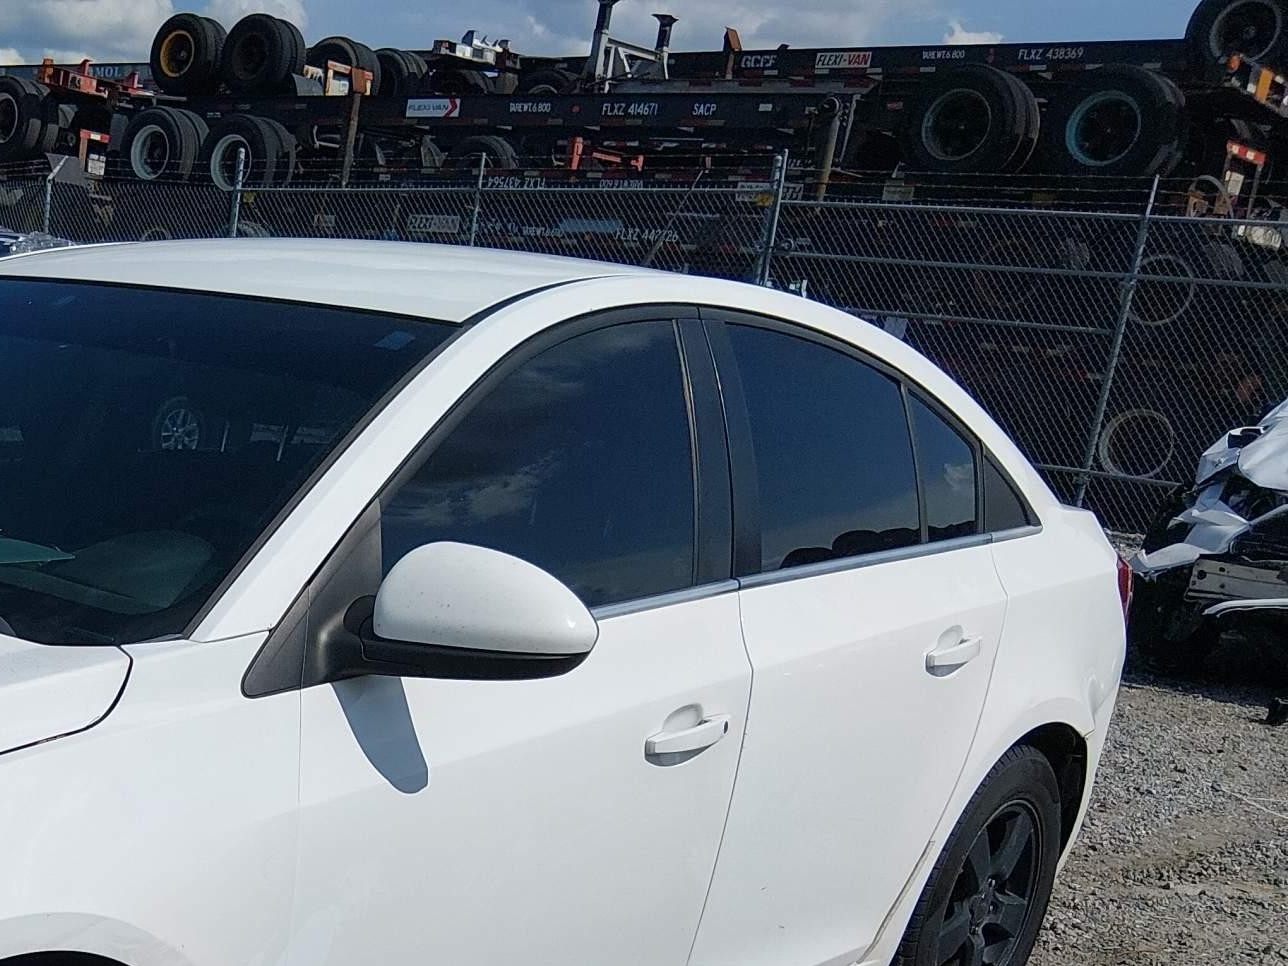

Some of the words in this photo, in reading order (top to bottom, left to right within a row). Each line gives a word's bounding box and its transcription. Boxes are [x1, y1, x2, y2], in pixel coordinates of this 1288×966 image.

[817, 53, 870, 67] FLEXI-VAN
[1018, 49, 1042, 60] FLXZ
[1046, 48, 1084, 60] 438369
[602, 103, 624, 115] FLXZ
[628, 103, 658, 115] 414671
[693, 103, 716, 116] SACP
